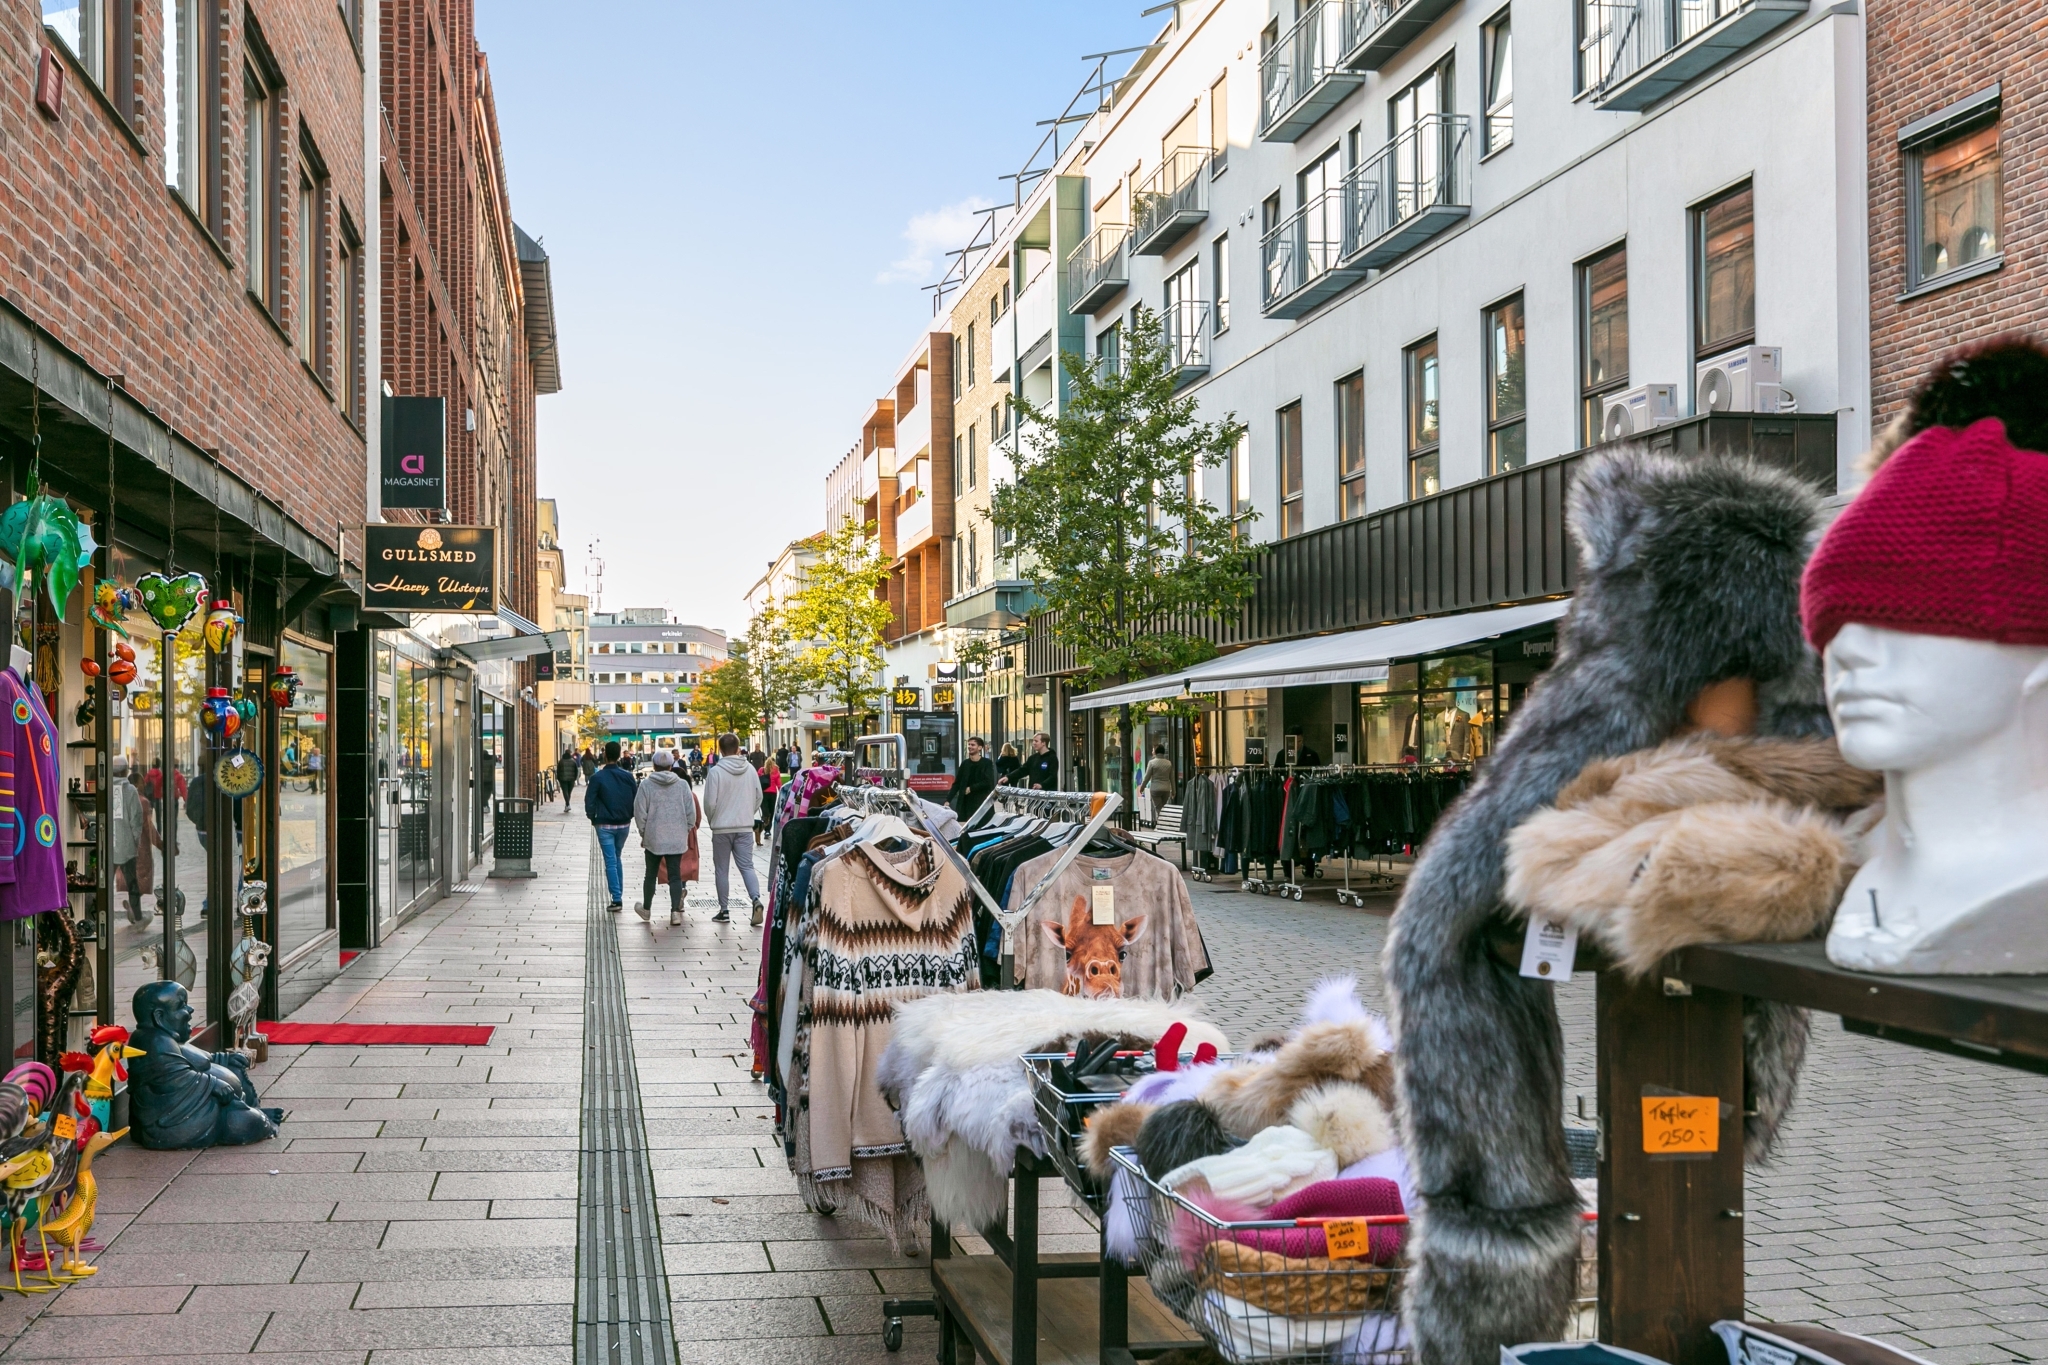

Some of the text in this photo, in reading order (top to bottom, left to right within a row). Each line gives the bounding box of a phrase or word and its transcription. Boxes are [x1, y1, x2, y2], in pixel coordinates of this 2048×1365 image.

[1728, 357, 1748, 369] SAMSUNG
[1629, 395, 1647, 405] SAMSUNG
[384, 477, 441, 487] MAGASINET
[382, 549, 476, 563] GULLSMED
[366, 575, 430, 595] Harry
[1247, 747, 1263, 755] -70%
